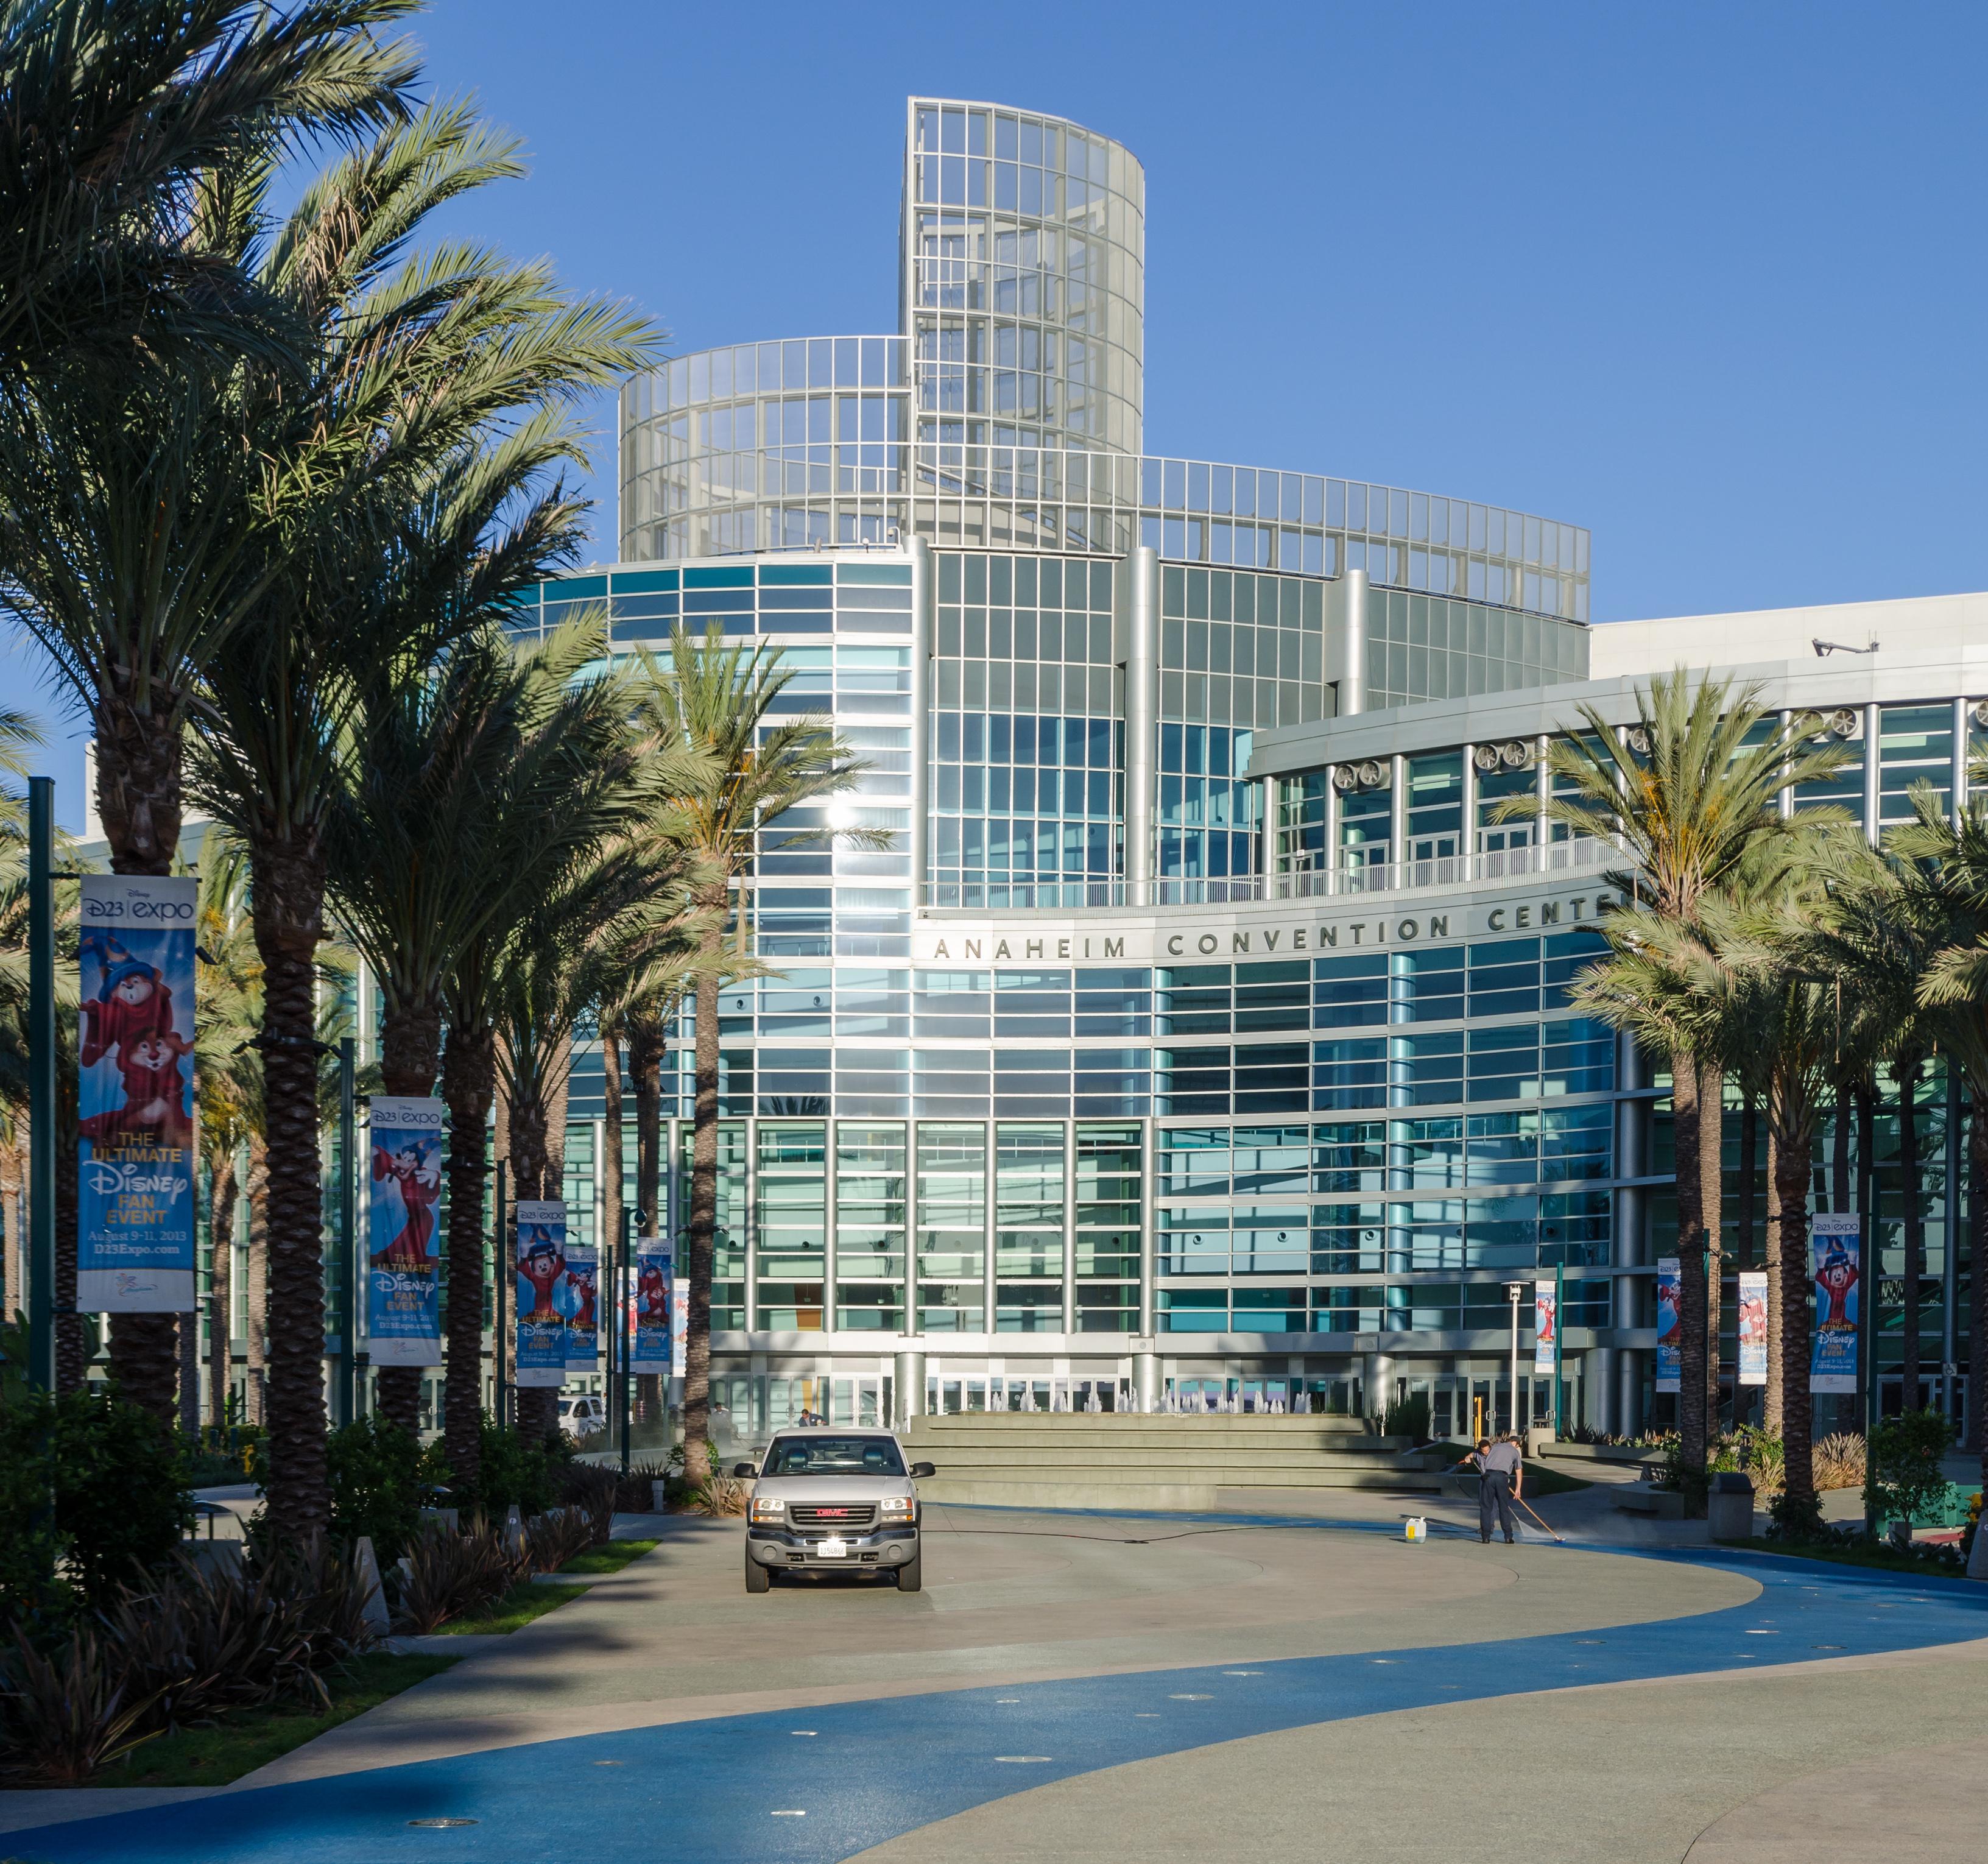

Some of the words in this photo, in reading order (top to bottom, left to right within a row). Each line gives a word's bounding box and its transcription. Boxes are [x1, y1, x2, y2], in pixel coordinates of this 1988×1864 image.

[83, 898, 124, 917] D23
[133, 902, 194, 922] expo
[934, 937, 1124, 959] ANAHEIM
[1168, 914, 1448, 955] CONVENTION
[372, 1110, 396, 1121] D23
[402, 1112, 440, 1125] expo
[119, 1132, 155, 1146] THE
[93, 1148, 182, 1162] ULTIMATE
[82, 1160, 188, 1205] Disney
[118, 1194, 155, 1209] FAN
[106, 1210, 167, 1224] EVENT
[519, 1210, 536, 1219] D23
[539, 1212, 565, 1220] expo
[1834, 1223, 1858, 1232] expo
[88, 1231, 129, 1243] August
[131, 1231, 157, 1241] 9-11,
[160, 1231, 187, 1241] 2013
[94, 1244, 180, 1257] D23Expo.com
[395, 1254, 416, 1263] THE
[377, 1263, 431, 1273] ULTIMATE
[372, 1271, 435, 1299] Disney
[394, 1292, 417, 1301] FAN
[386, 1301, 425, 1311] EVENT
[518, 1322, 563, 1340] Disney
[1817, 1330, 1855, 1349] Disney
